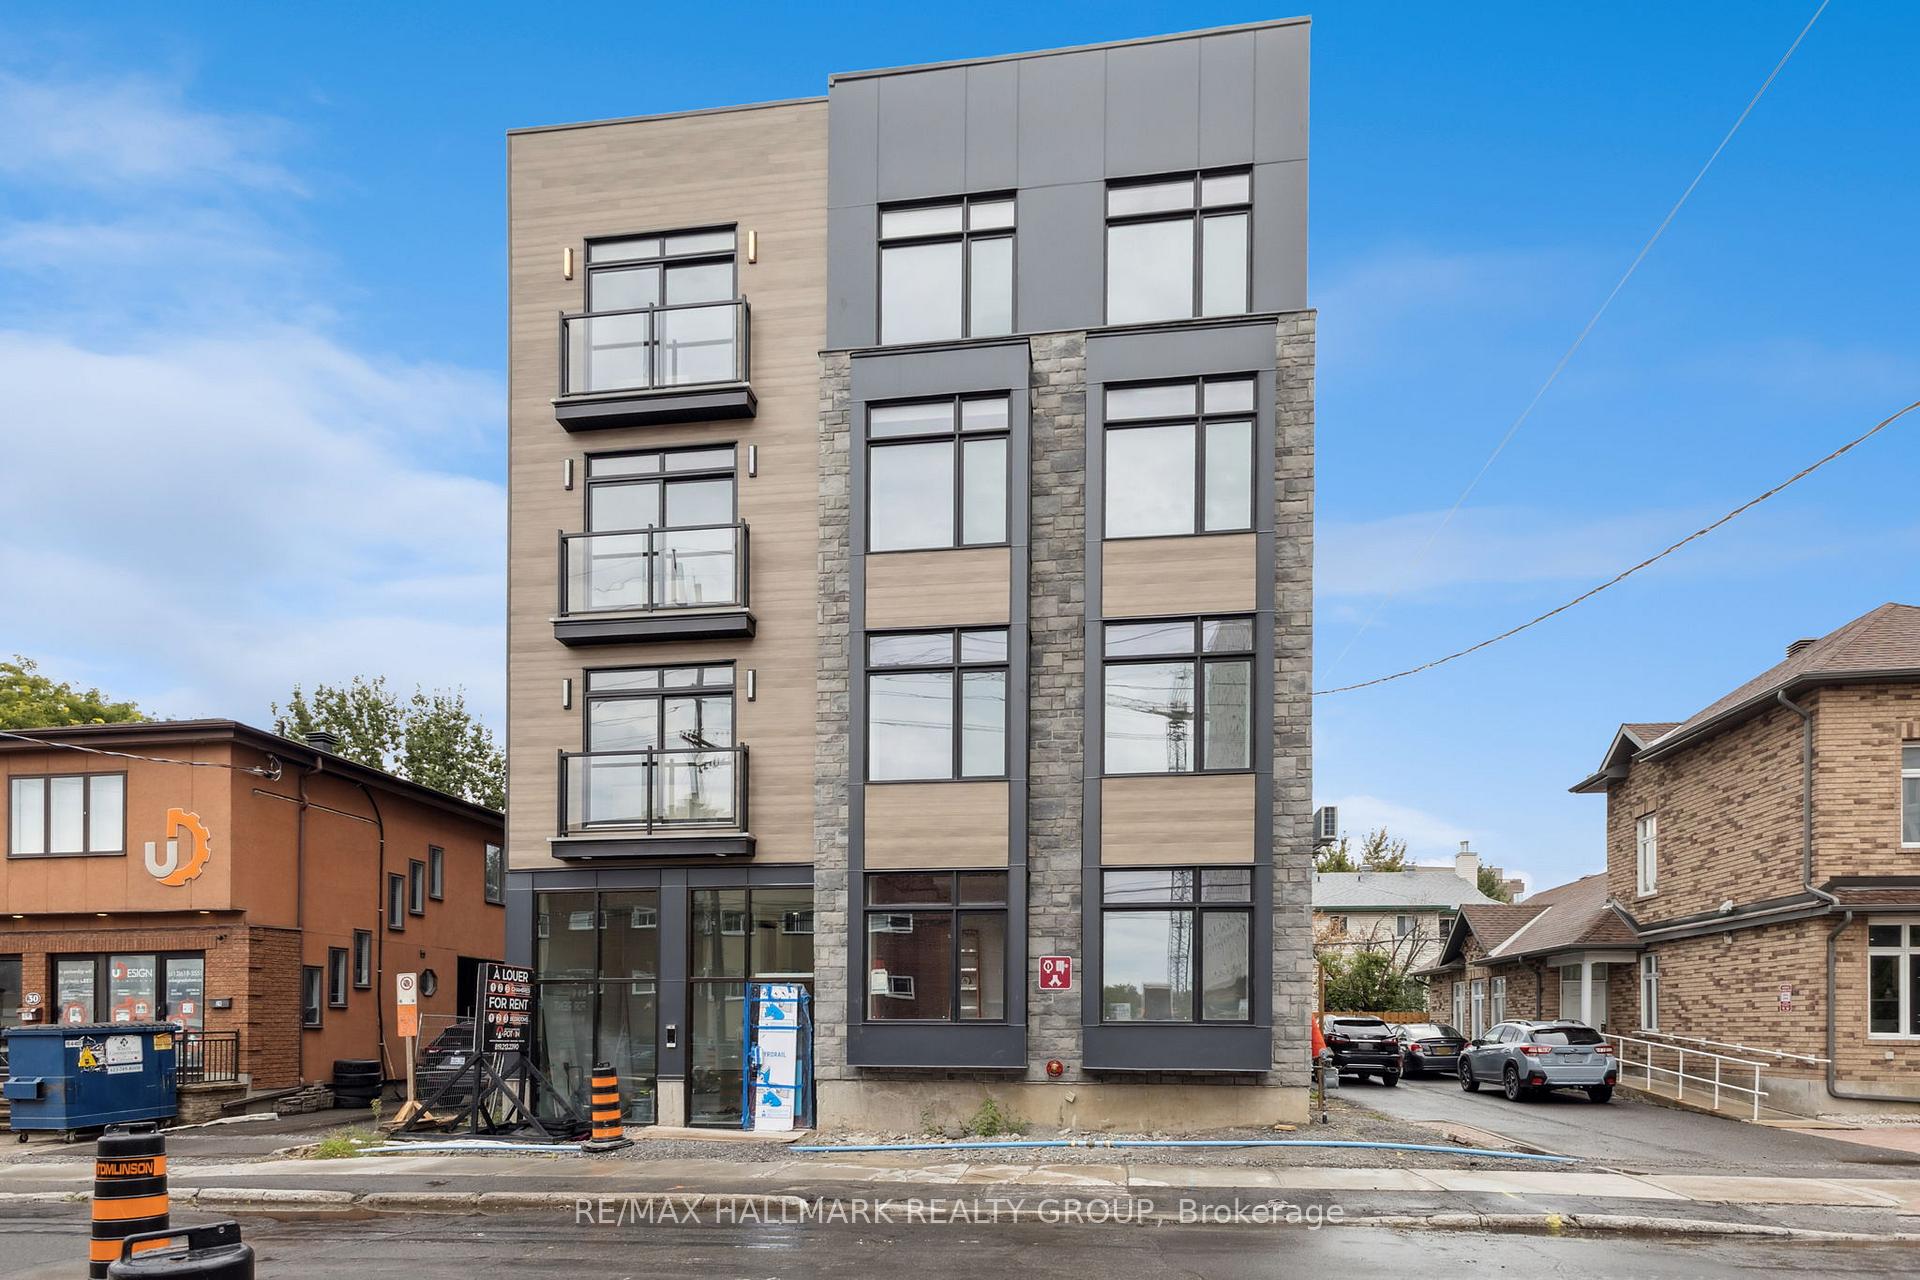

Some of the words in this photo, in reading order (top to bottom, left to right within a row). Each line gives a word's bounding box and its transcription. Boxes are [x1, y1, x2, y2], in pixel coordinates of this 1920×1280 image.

[493, 965, 501, 979] À
[502, 968, 529, 982] LOUER
[489, 997, 507, 1009] FOR
[509, 998, 529, 1010] RENT
[97, 1162, 154, 1175] TOMLINSON
